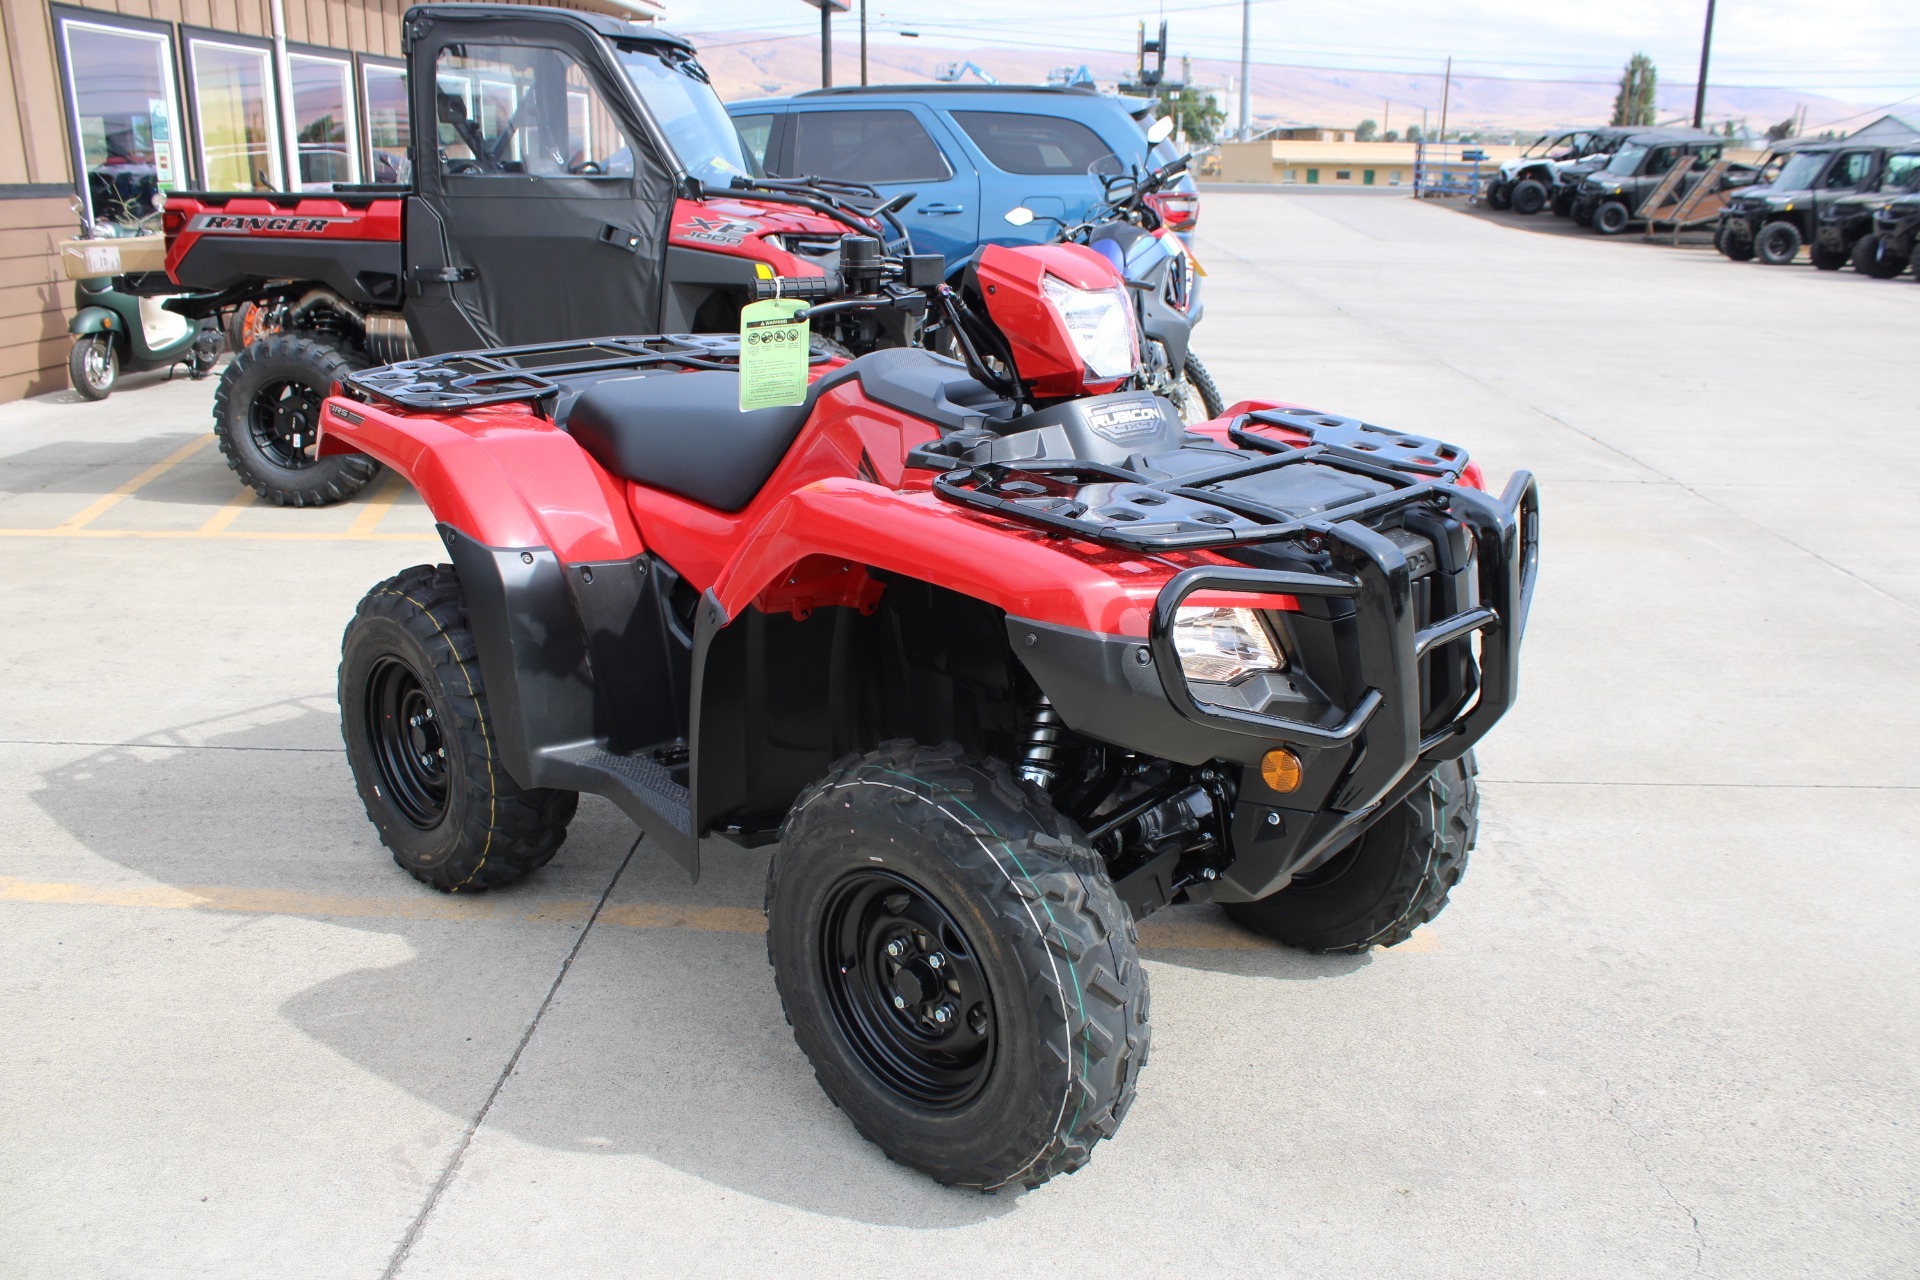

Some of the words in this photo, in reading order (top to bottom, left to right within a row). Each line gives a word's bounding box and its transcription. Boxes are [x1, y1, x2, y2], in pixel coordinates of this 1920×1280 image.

[203, 216, 329, 233] RANGER
[677, 216, 757, 233] XP
[687, 231, 744, 246] 1000
[332, 405, 349, 417] IRS
[1090, 408, 1160, 429] RUBICON
